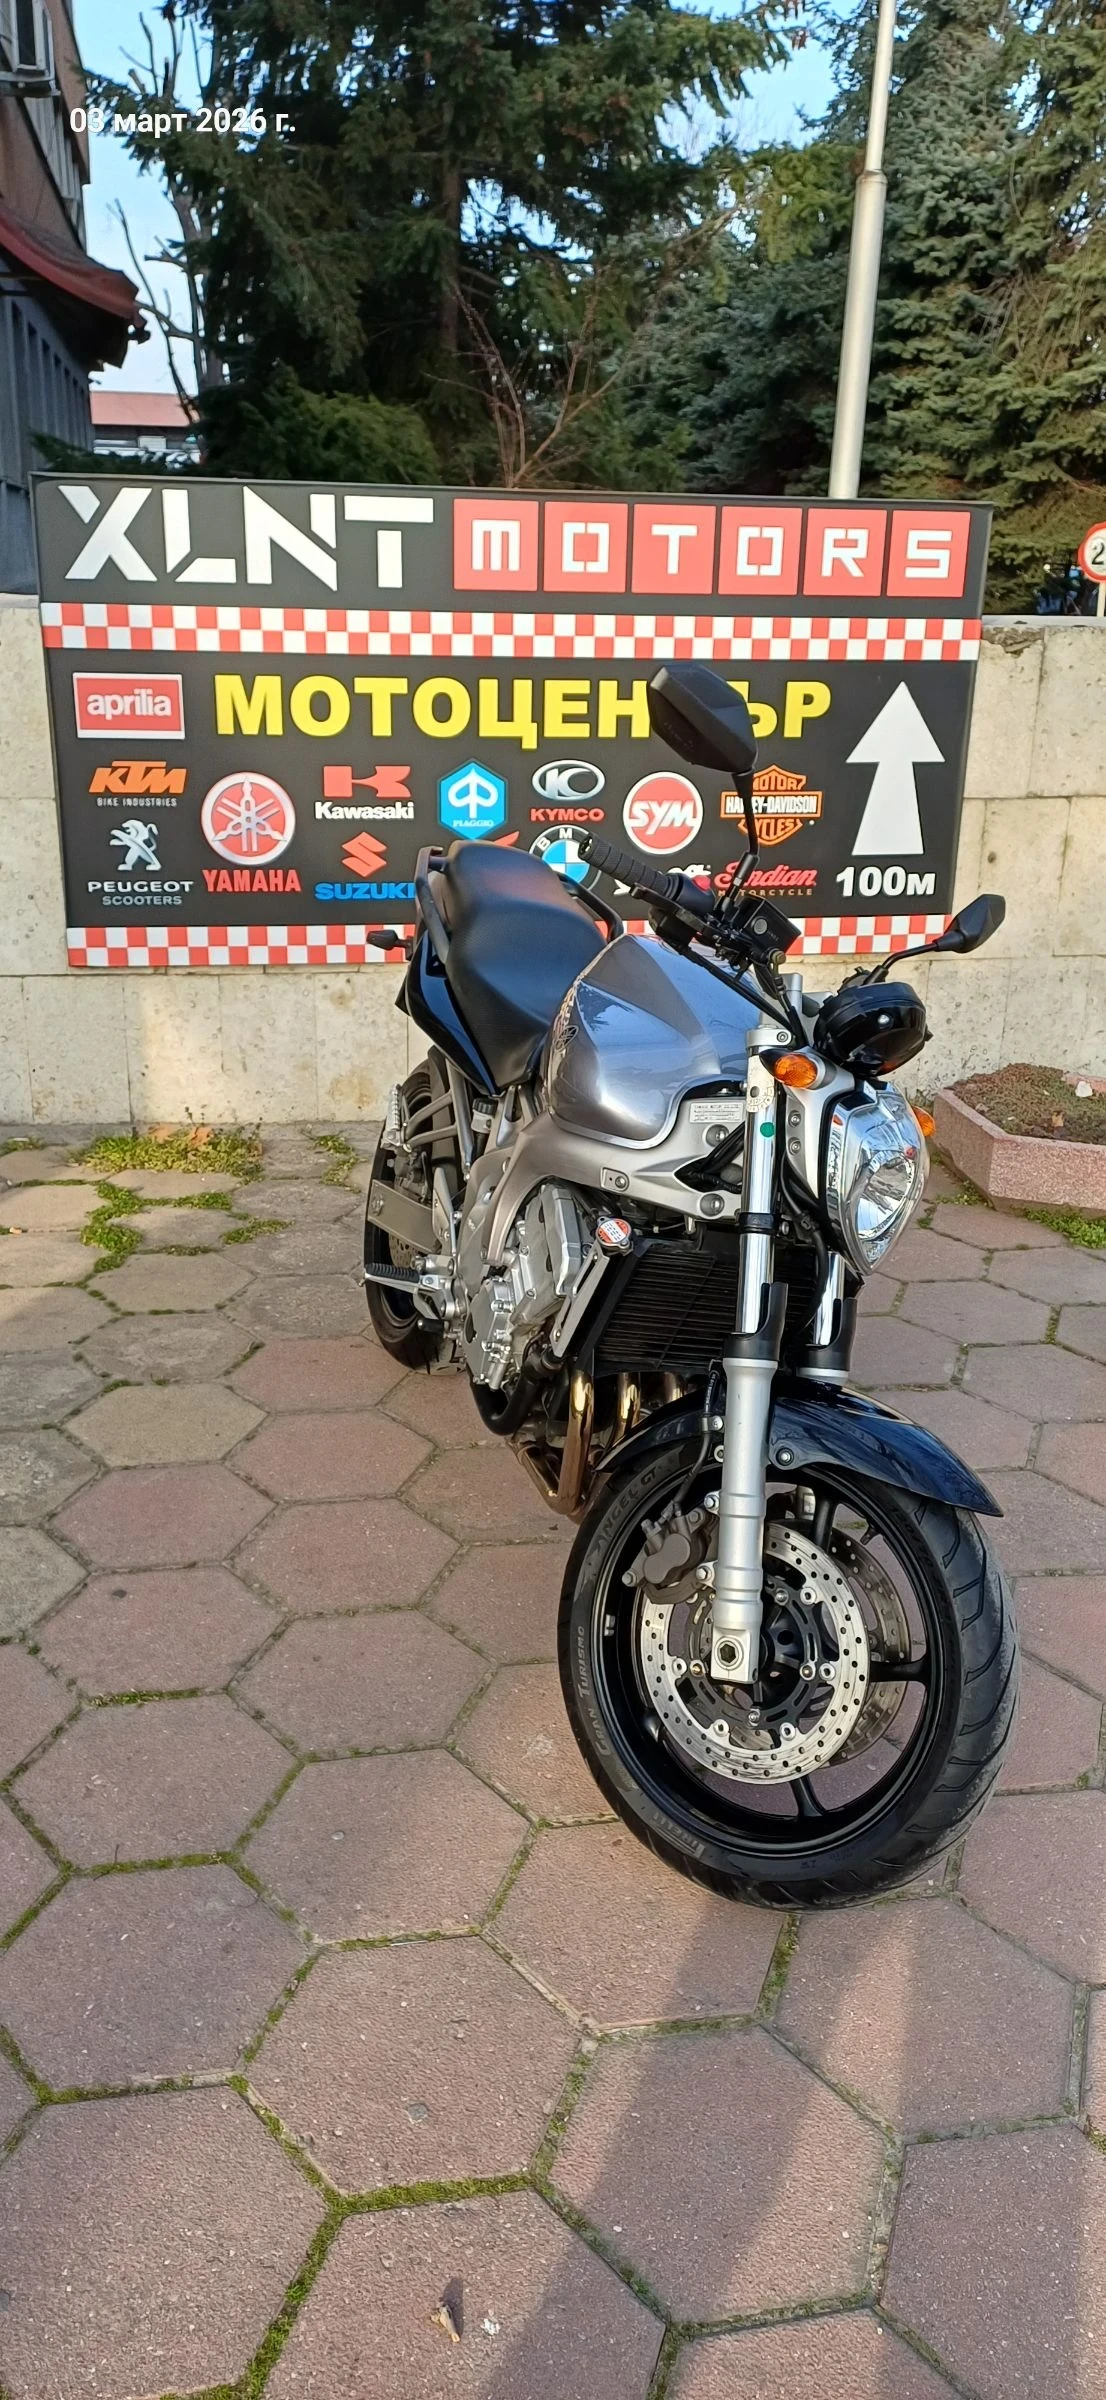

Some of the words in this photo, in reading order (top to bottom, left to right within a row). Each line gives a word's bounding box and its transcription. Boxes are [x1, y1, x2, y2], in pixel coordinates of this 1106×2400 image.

[58, 485, 434, 592] XLNT
[472, 519, 953, 577] MOTORS
[86, 688, 172, 721] aprilia
[214, 674, 831, 749] МОТОЦЕНЪР
[88, 760, 187, 794] KTM
[96, 797, 119, 807] BIKE
[122, 797, 178, 807] INDUSTRIES
[314, 801, 415, 820] Kawasaki
[725, 795, 818, 814] HAEY-DAVIDSON
[452, 819, 495, 828] PIAGGIO
[530, 808, 605, 822] KYMCO
[630, 800, 698, 835] SYM
[755, 818, 795, 839] YCLES
[88, 881, 194, 893] PEUGEOT
[202, 869, 302, 892] YAMAHA
[102, 895, 182, 905] SCOOTERS
[315, 883, 416, 900] SUZUKI
[718, 888, 812, 896] MTORCYCLE
[577, 1625, 591, 1699] TURISMO
